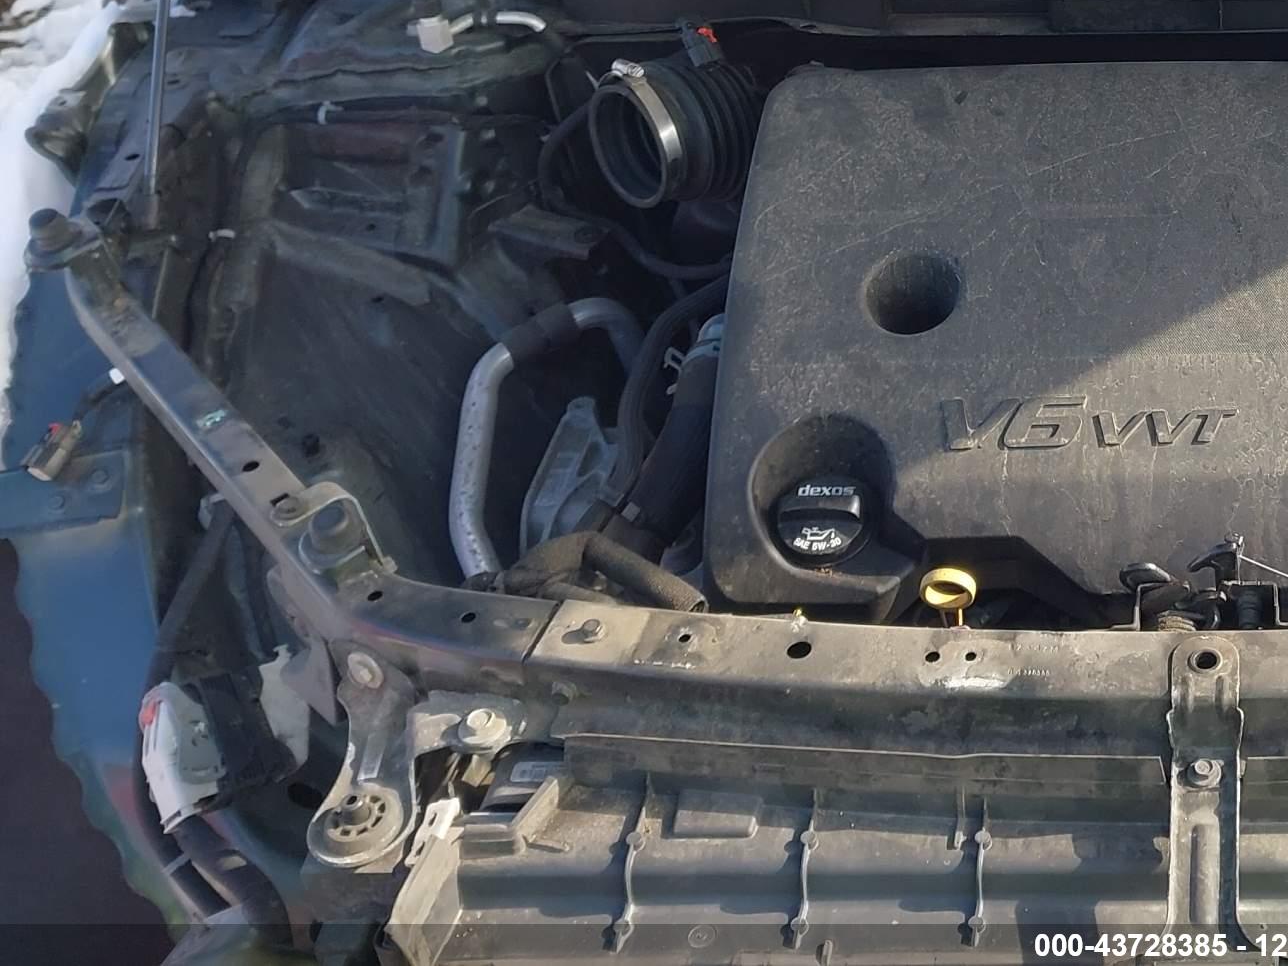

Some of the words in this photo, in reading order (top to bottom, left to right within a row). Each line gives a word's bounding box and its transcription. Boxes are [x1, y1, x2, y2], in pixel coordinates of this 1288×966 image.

[940, 394, 1087, 452] V6
[1091, 408, 1240, 448] VVT
[798, 484, 857, 497] dexos
[793, 537, 811, 551] SAE
